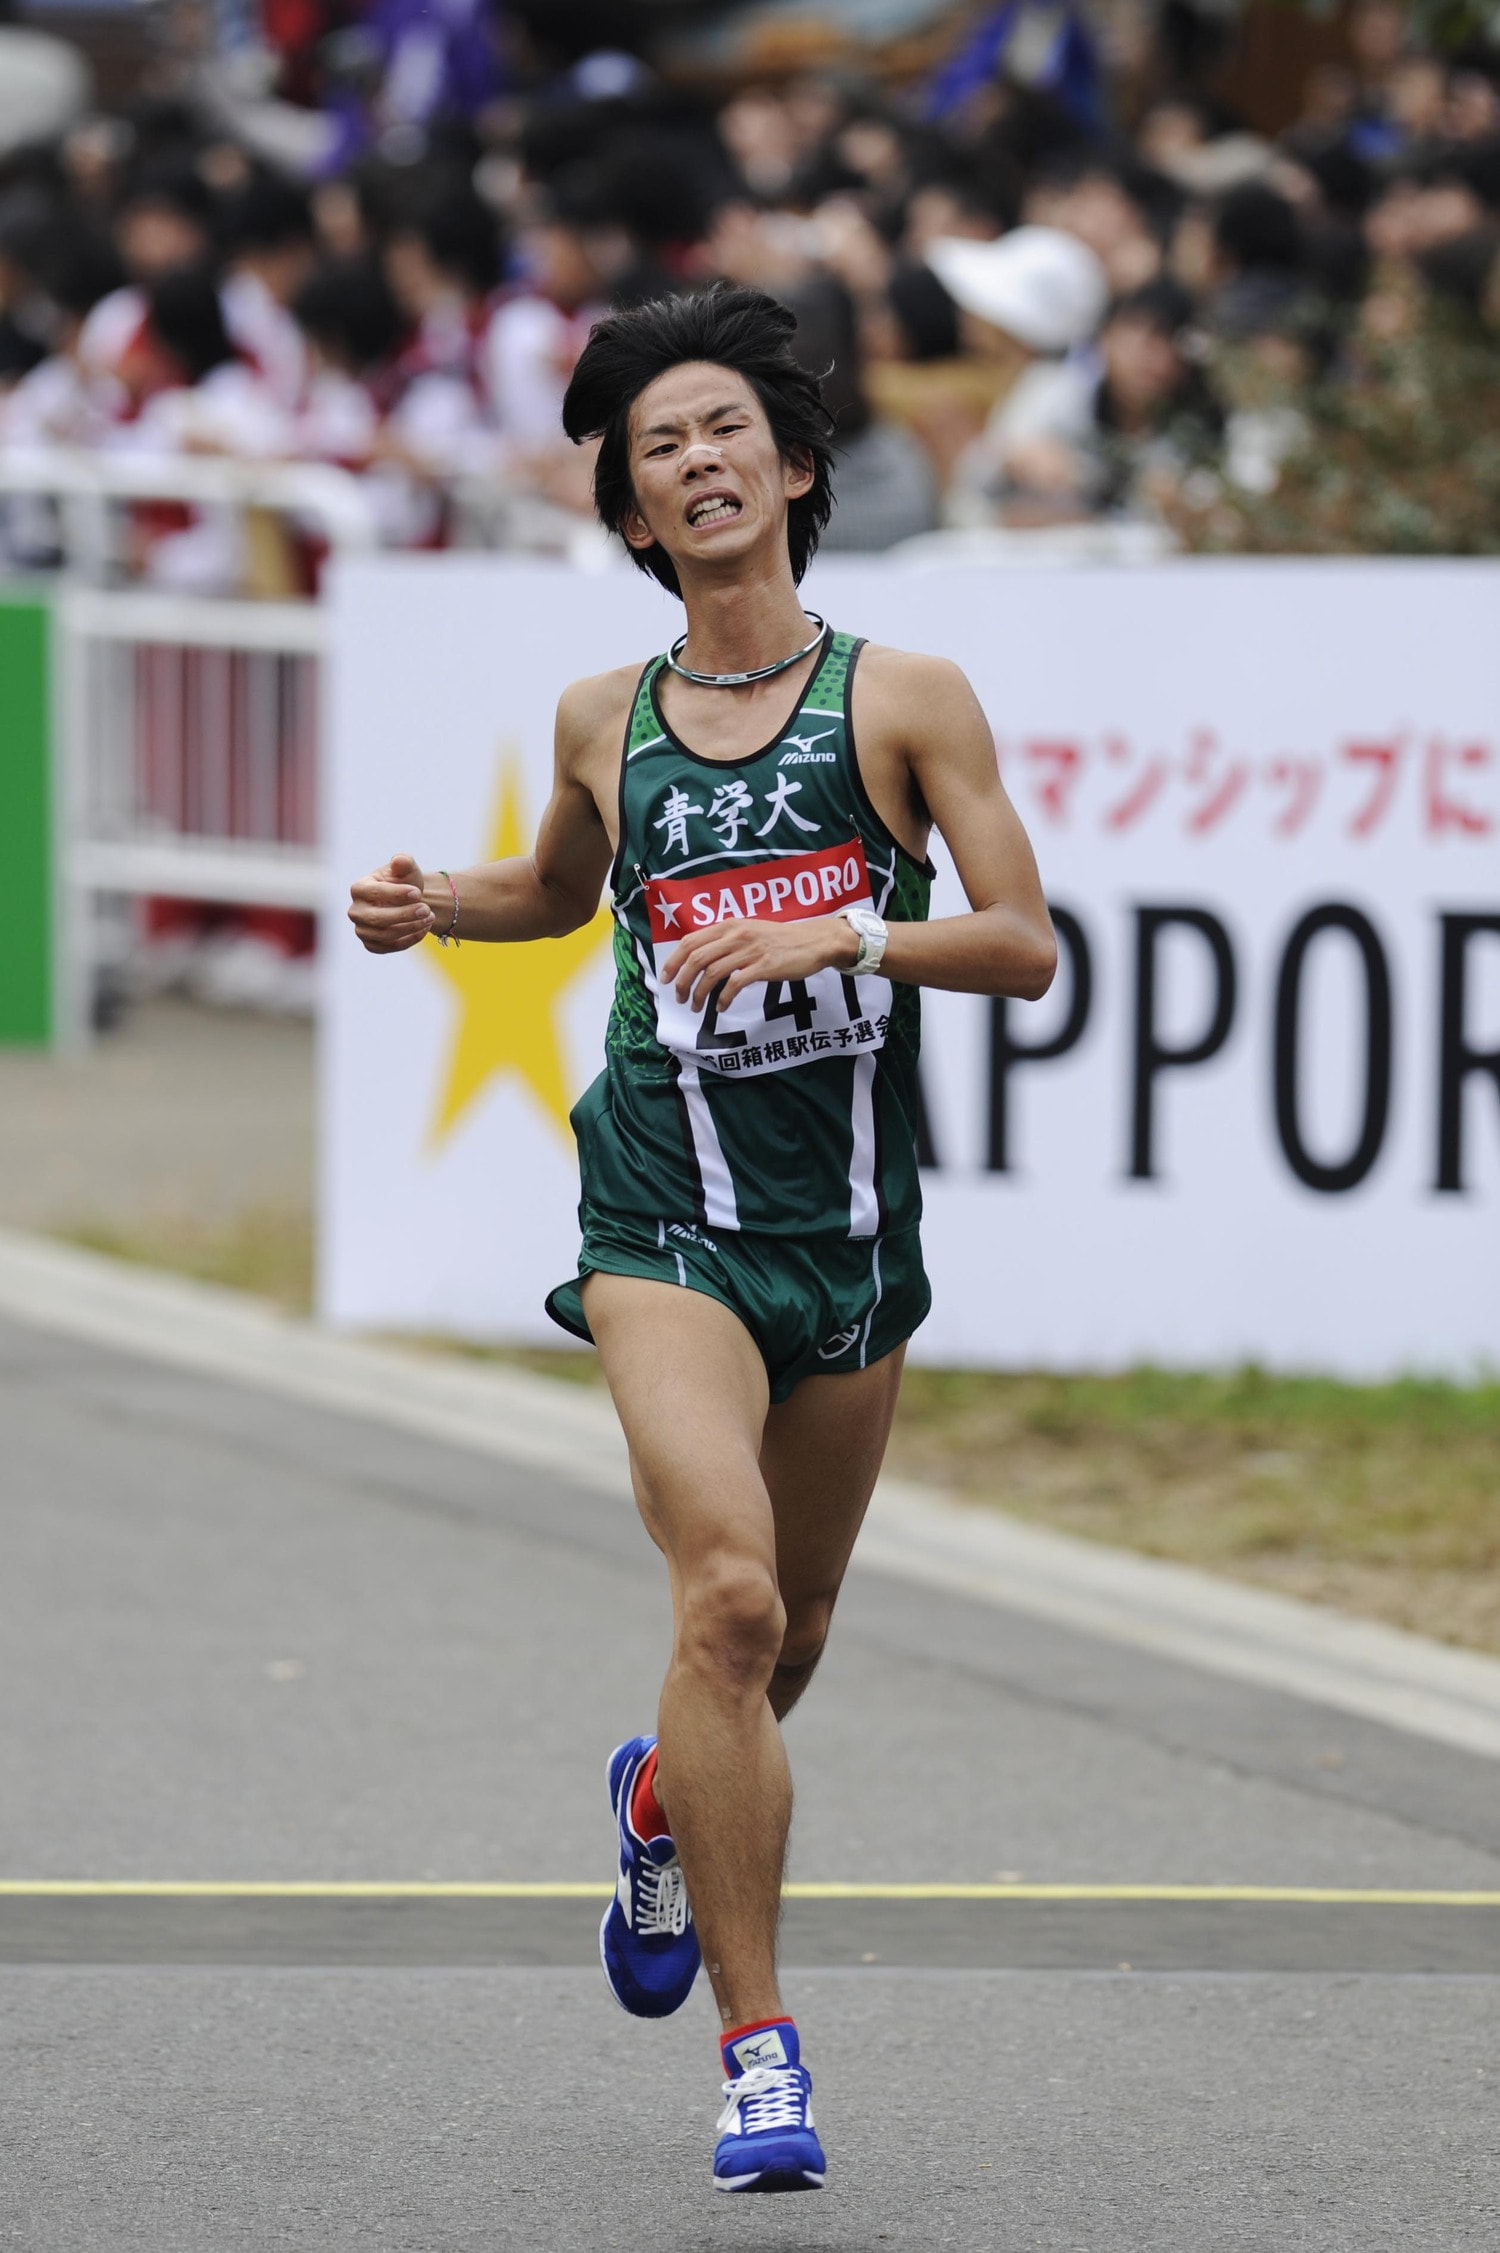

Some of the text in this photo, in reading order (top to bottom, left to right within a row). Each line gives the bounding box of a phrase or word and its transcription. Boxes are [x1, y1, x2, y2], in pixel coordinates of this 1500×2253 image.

[777, 751, 837, 767] MIZUNO
[998, 726, 1494, 838] マンシップに
[653, 771, 822, 857] 青学大
[690, 856, 860, 926] SAPPORO
[914, 900, 1500, 1193] PPOR
